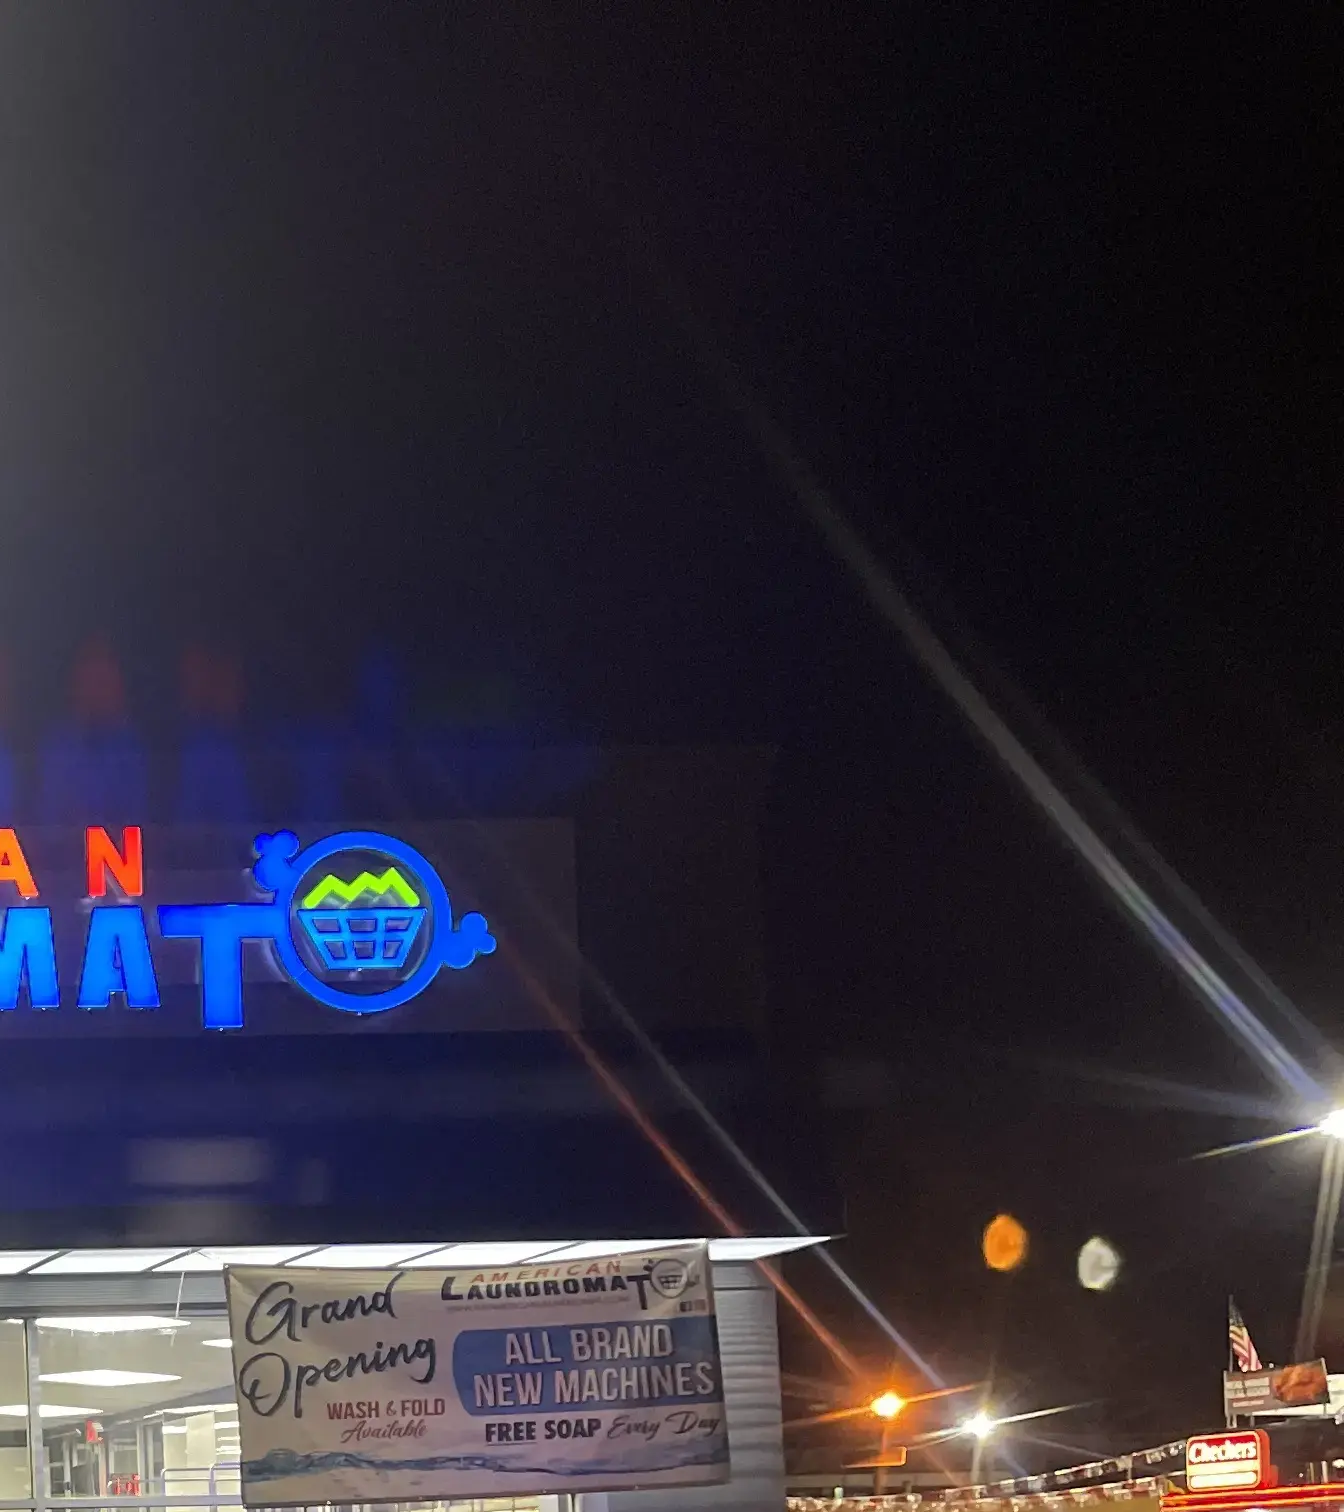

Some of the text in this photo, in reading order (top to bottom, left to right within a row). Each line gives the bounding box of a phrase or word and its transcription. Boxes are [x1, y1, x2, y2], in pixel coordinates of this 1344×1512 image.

[469, 1260, 622, 1283] AMERICAN
[245, 1269, 411, 1345] Grand
[441, 1274, 652, 1311] LAUNDROMAT
[505, 1324, 674, 1366] ALL BRAND
[239, 1337, 437, 1419] Opening
[473, 1362, 714, 1408] NEW MACHINES
[326, 1398, 446, 1420] WASH & FOLD
[485, 1410, 720, 1443] FREE SOAP Every Day
[340, 1418, 429, 1444] Available
[1188, 1439, 1257, 1464] Checkers
